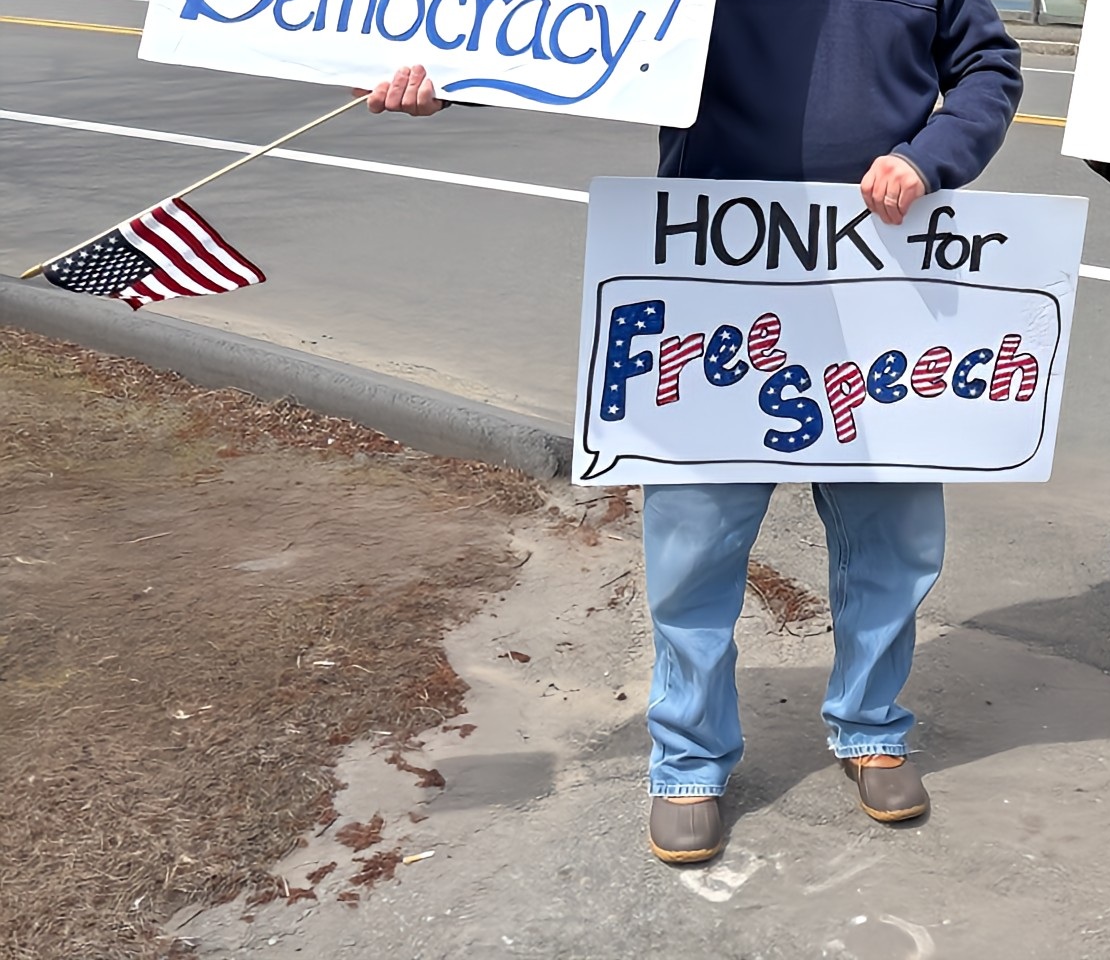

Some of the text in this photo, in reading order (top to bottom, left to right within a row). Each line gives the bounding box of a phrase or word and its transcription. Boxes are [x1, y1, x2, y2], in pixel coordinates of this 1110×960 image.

[654, 191, 1008, 272] HONK for
[600, 299, 787, 421] Free
[758, 334, 1039, 452] Speech
